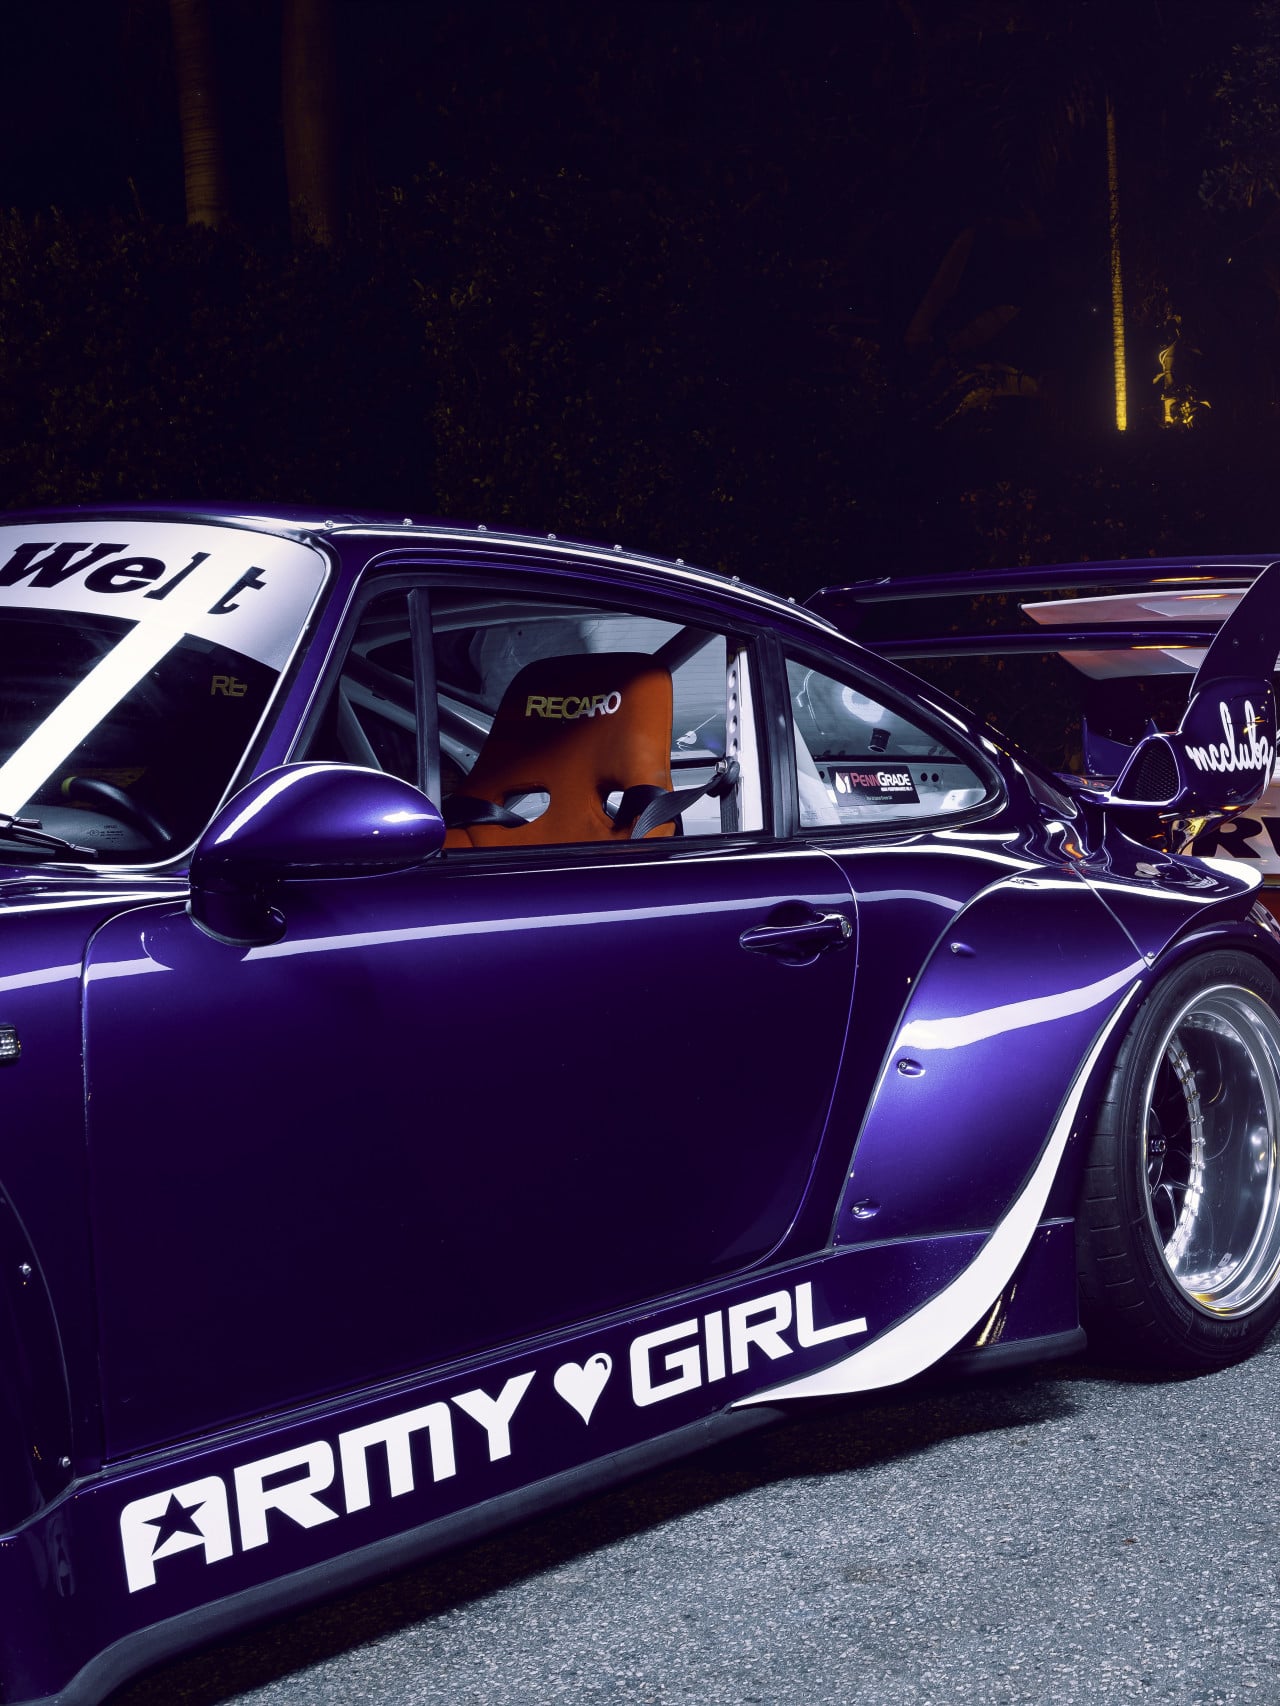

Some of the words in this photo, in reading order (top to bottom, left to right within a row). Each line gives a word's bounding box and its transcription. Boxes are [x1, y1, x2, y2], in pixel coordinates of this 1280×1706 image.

[525, 690, 622, 719] RECARO
[119, 1370, 537, 1594] ARMY
[629, 1281, 868, 1407] GIRL
